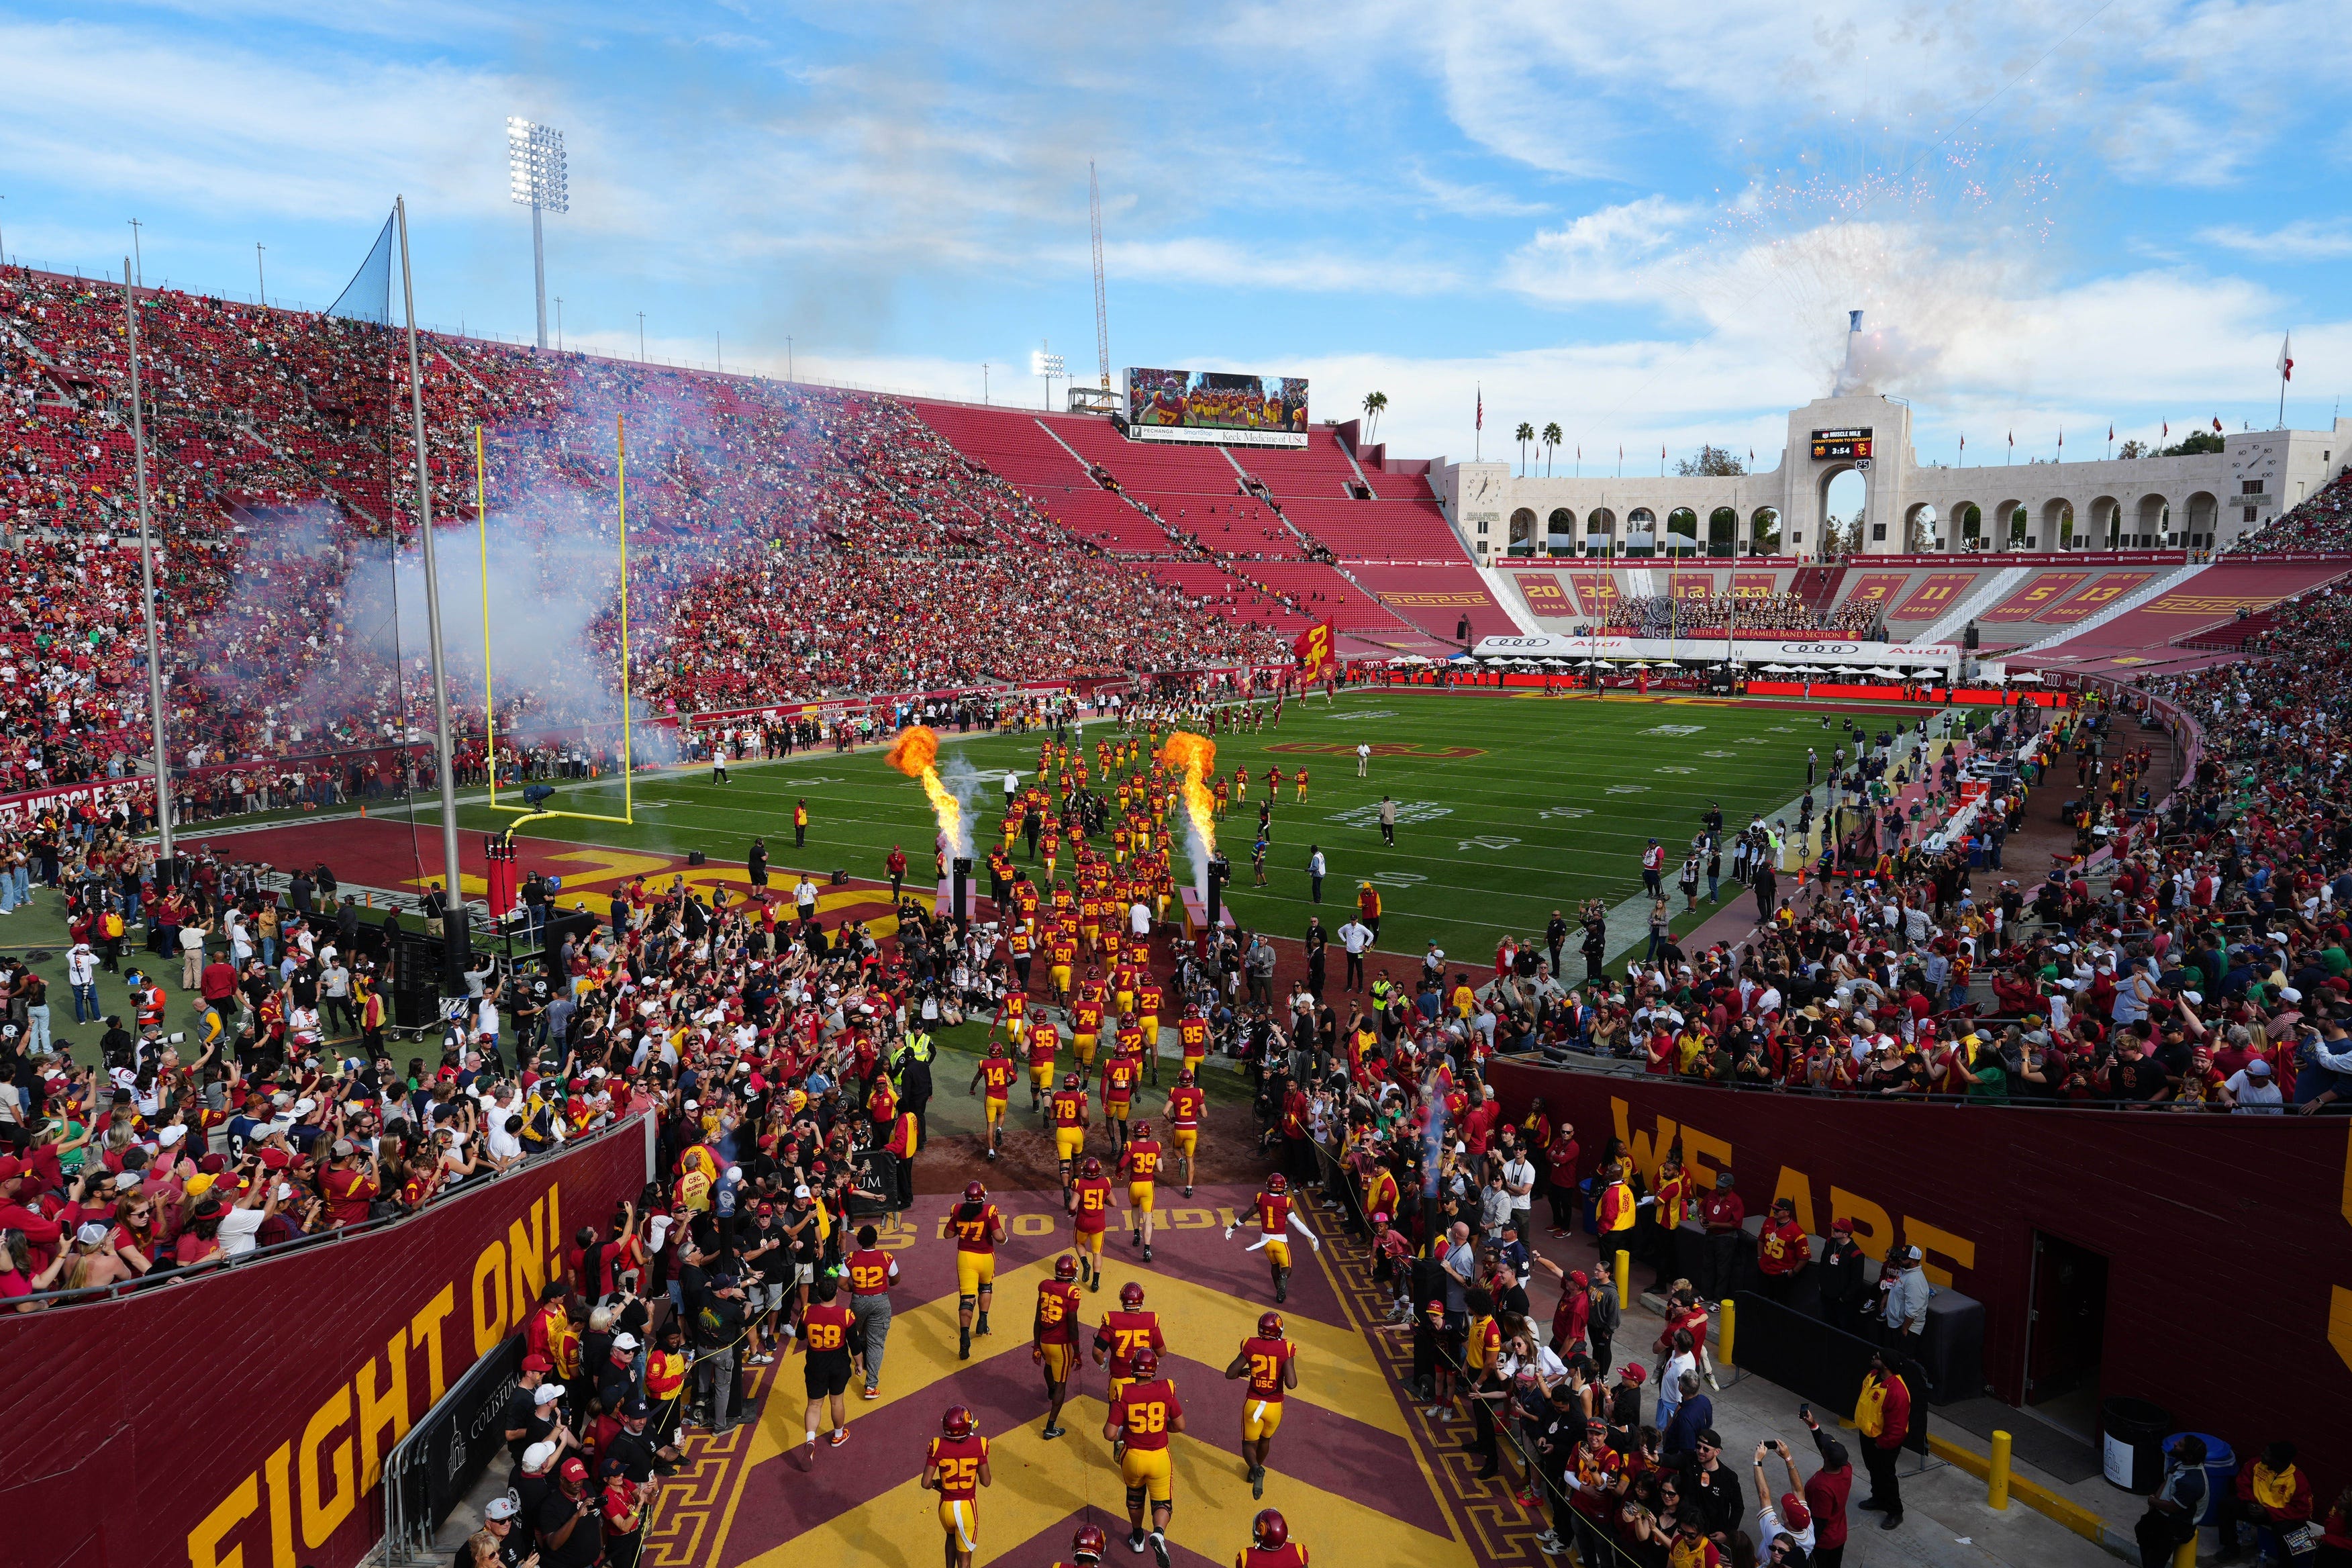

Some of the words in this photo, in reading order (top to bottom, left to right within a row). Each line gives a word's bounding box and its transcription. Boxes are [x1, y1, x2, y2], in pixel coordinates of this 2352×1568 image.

[1183, 429, 1213, 437] SmartStop
[1222, 432, 1241, 442] Keck
[1244, 433, 1277, 444] Medicine
[1277, 434, 1287, 444] of
[1288, 435, 1306, 444] USC
[1524, 585, 1561, 597] 20
[1579, 585, 1616, 598] 32
[1863, 587, 1887, 599] 3
[1920, 587, 1952, 599] 11
[2024, 587, 2057, 601] 5
[2075, 587, 2122, 601] 13
[1638, 624, 1689, 639] Allstate
[2065, 679, 2079, 687] Audi
[1061, 776, 1069, 785] 91
[1236, 773, 1244, 781] 27
[1119, 787, 1128, 795] 57
[1604, 784, 1652, 795] 40
[1027, 793, 1038, 801] 90
[1040, 797, 1050, 805] 82
[1153, 799, 1163, 807] 99
[1014, 804, 1024, 813] 29
[1538, 806, 1595, 820] 30
[1394, 808, 1454, 824] FIELD
[1005, 822, 1014, 832] 91
[1071, 829, 1081, 839] 40
[1138, 823, 1149, 832] 98
[1114, 832, 1125, 842] 86
[1157, 836, 1167, 846] 40
[1457, 834, 1522, 851] 20
[999, 869, 1013, 881] 59
[1355, 871, 1429, 889] 10
[1157, 882, 1168, 893] 13
[1022, 898, 1036, 912] 30
[1084, 903, 1099, 916] 88
[1101, 901, 1116, 913] 39
[1061, 920, 1077, 932] 76
[1012, 936, 1027, 950] 29
[1104, 936, 1118, 951] 19
[1055, 948, 1071, 962] 60
[1132, 948, 1148, 963] 30
[1122, 971, 1131, 985] 7
[1007, 998, 1022, 1014] 14
[1141, 993, 1159, 1009] 23
[1078, 1010, 1097, 1026] 74
[1035, 1030, 1055, 1046] 95
[1183, 1026, 1203, 1043] 85
[1120, 1034, 1142, 1052] 22
[987, 1067, 1005, 1085] 14
[1112, 1068, 1130, 1081] 41
[1055, 1099, 1076, 1119] 78
[1180, 1097, 1193, 1116] 2
[232, 1134, 243, 1159] 3
[1133, 1152, 1156, 1173] 39
[685, 1181, 705, 1193] SECURITY
[688, 1176, 701, 1184] CSC
[1083, 1189, 1104, 1210] 51
[1611, 1095, 1733, 1208] WE
[1770, 1165, 1975, 1290] ARE
[1266, 1206, 1275, 1229] 1
[956, 1221, 985, 1241] 77
[1763, 1235, 1784, 1260] 35
[852, 1266, 884, 1288] 92
[1040, 1297, 1065, 1321] 26
[806, 1323, 842, 1349] 68
[1115, 1329, 1150, 1359] 75
[1250, 1353, 1278, 1381] 21
[187, 1281, 454, 1568] FIGHT
[472, 1182, 562, 1359] ON!
[1255, 1379, 1274, 1388] USC
[471, 1371, 522, 1439] COLISEUM
[1128, 1402, 1167, 1434] 58
[570, 1463, 583, 1473] USC
[939, 1457, 979, 1490] 25
